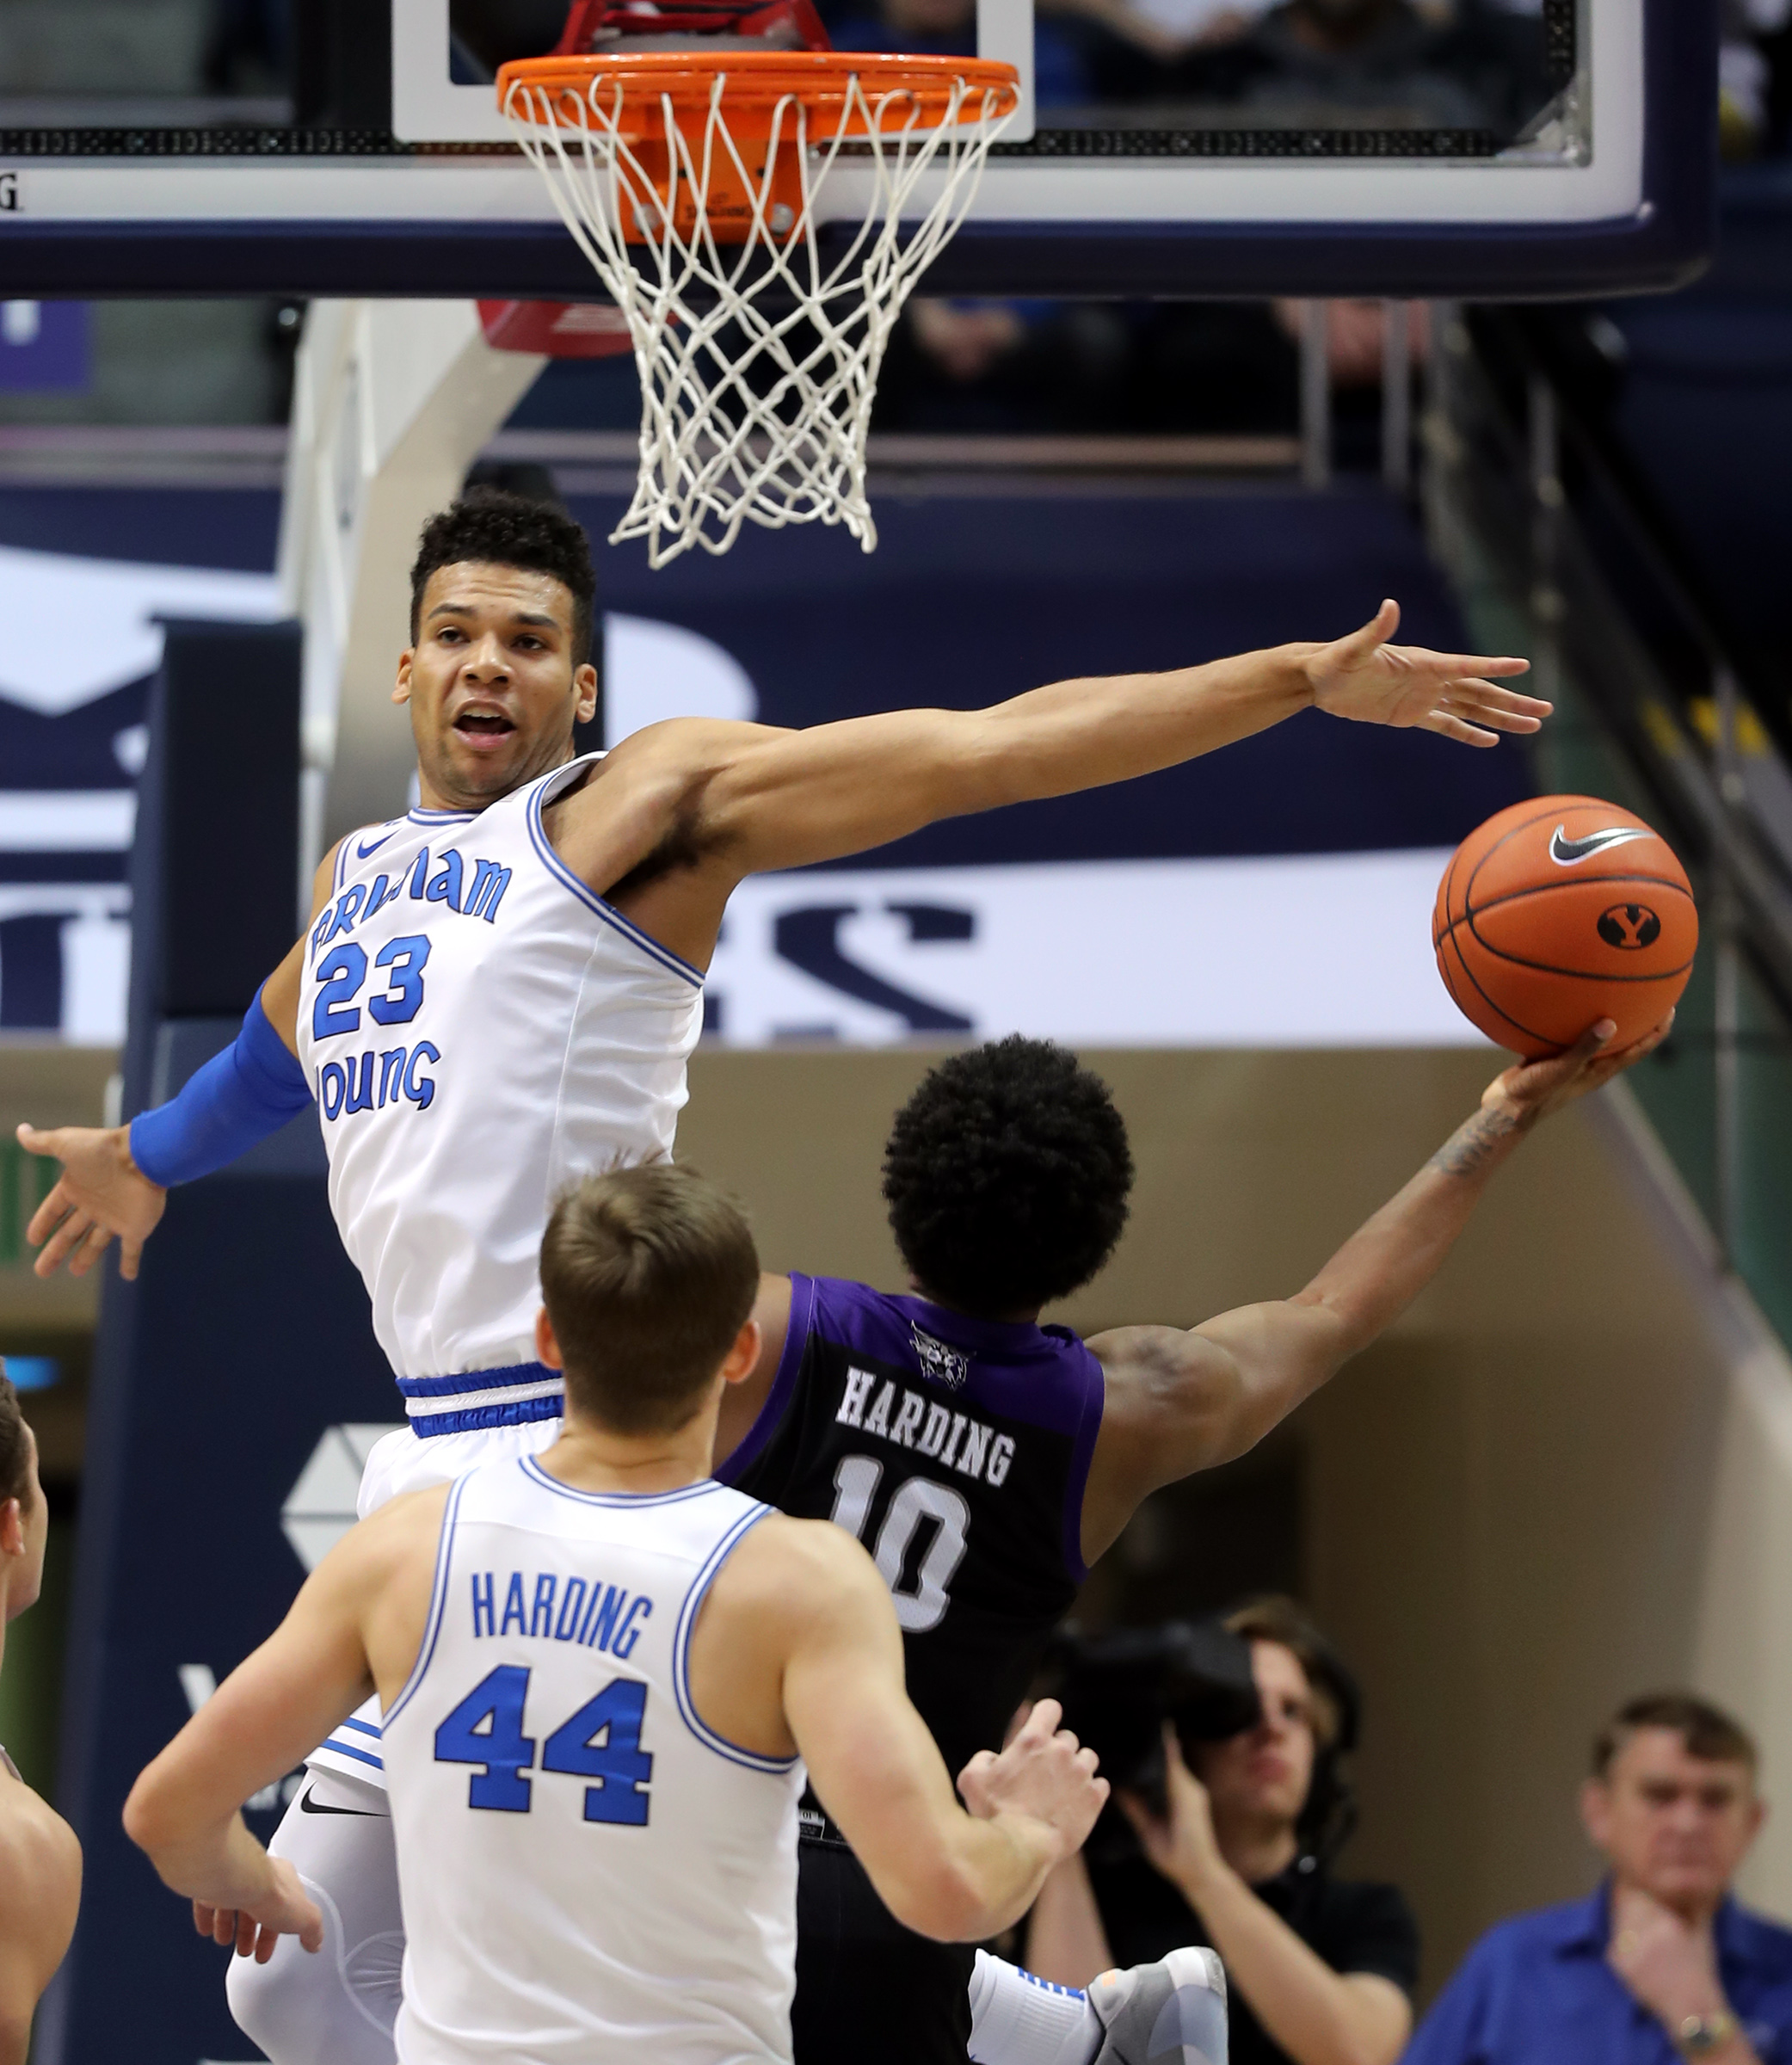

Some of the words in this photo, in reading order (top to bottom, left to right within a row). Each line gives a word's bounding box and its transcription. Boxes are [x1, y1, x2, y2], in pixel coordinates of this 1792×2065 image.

[1606, 905, 1653, 947] Y
[313, 934, 432, 1042] 23
[834, 1365, 1016, 1488] HARDING
[830, 1452, 971, 1633] 10
[471, 1572, 653, 1660] HARDING
[434, 1663, 654, 1827] 44
